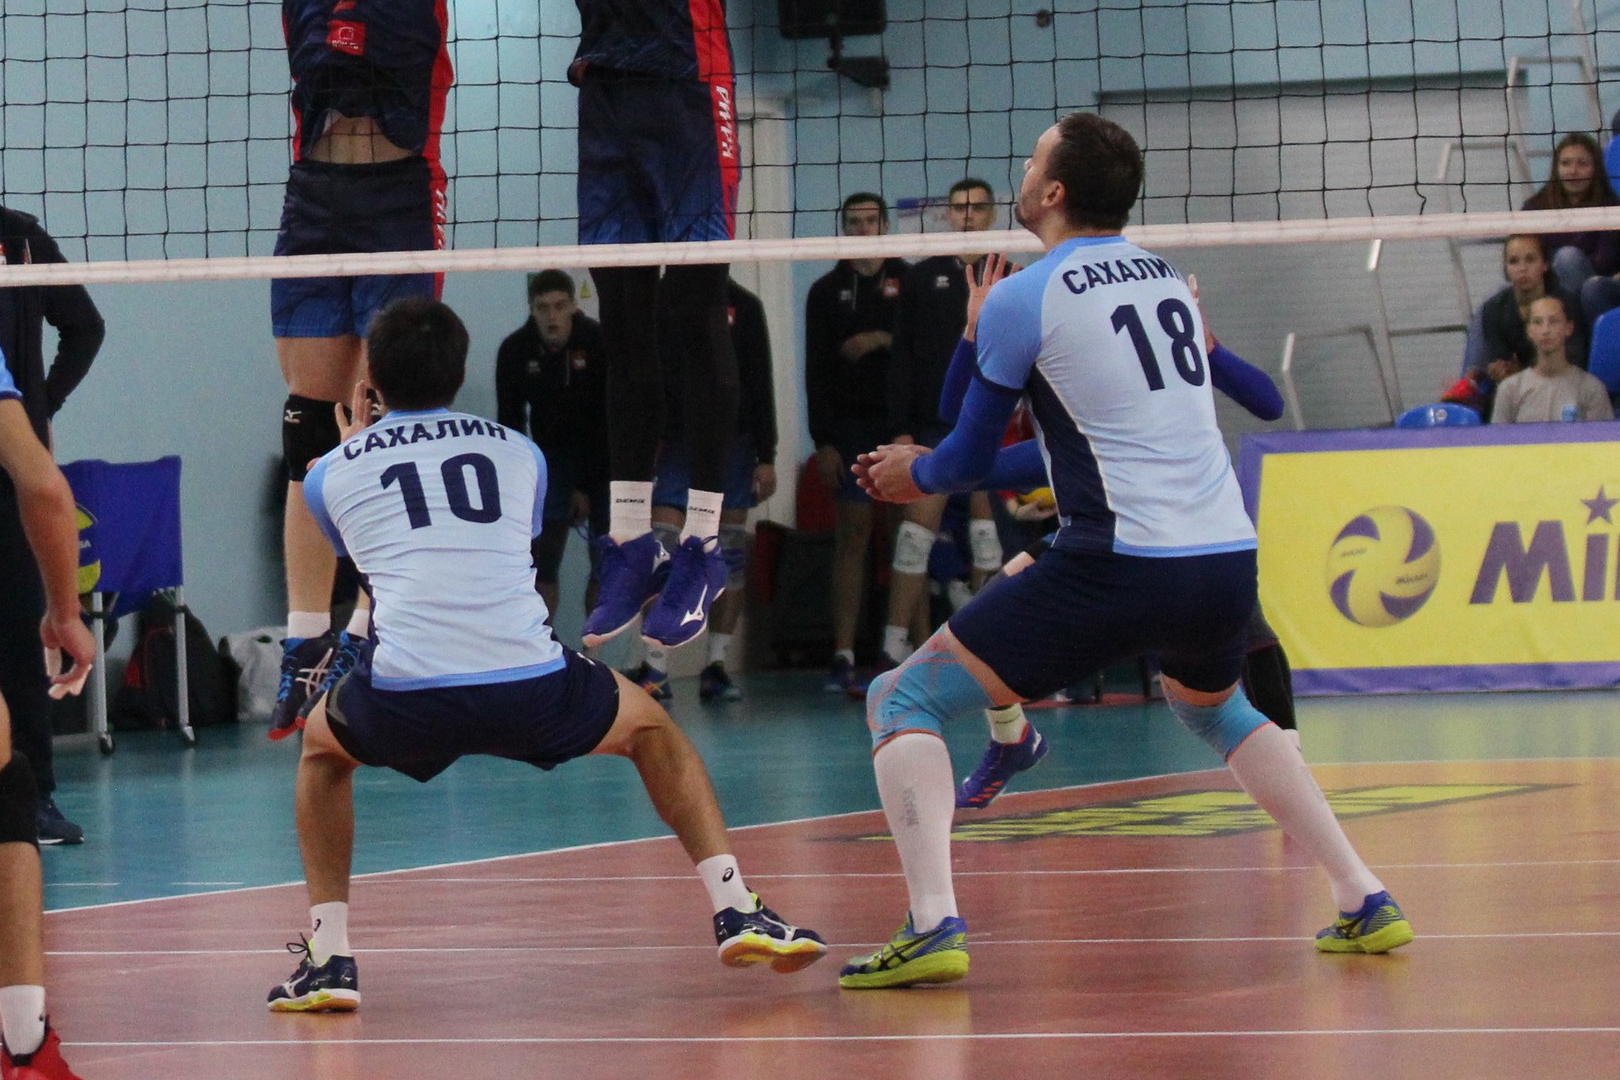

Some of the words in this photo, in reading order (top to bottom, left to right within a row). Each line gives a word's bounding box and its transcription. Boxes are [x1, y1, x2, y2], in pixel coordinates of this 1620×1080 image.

[1110, 297, 1206, 392] 18
[343, 418, 508, 461] САХАЛИН
[380, 452, 503, 530] 10
[1469, 484, 1620, 605] Mi
